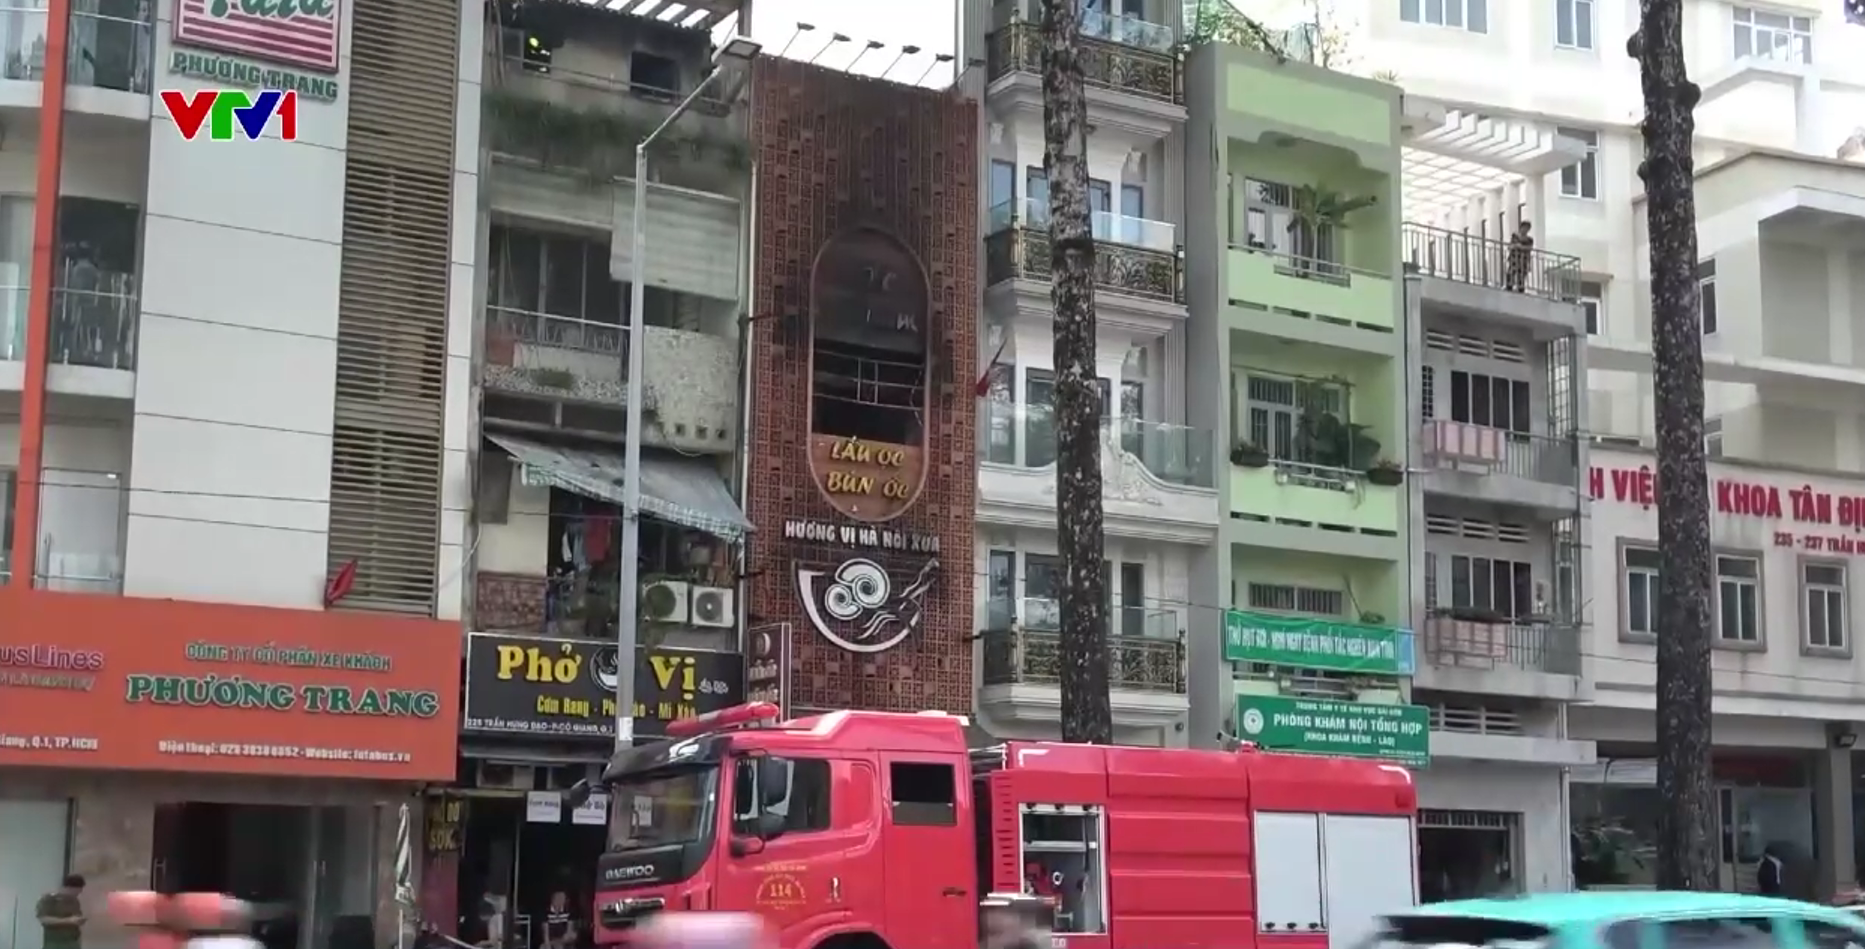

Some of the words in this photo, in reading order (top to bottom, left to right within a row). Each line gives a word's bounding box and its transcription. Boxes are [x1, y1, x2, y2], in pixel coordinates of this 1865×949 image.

[171, 52, 260, 86] PHƯƠNG
[266, 70, 338, 99] TRANG
[1717, 480, 1782, 519] KHOA
[1789, 484, 1832, 524] TÂN
[785, 520, 836, 542] HƯƠNG
[840, 526, 856, 549] VỊ
[859, 525, 878, 546] HÀ
[1774, 531, 1794, 548] 235
[1805, 535, 1823, 550] 237
[321, 652, 341, 668] XE
[498, 644, 582, 683] Phở
[650, 655, 696, 700] Vị
[126, 673, 296, 711] PHƯƠNG
[302, 684, 440, 717] TRANG
[537, 695, 559, 714] Cơm
[563, 698, 589, 717] Rang
[602, 699, 617, 717] Ph
[1273, 713, 1312, 728] PHÒNG
[1315, 714, 1345, 729] KHÁM
[1349, 717, 1367, 732] NỘI
[605, 864, 654, 880] DAEWOO
[770, 883, 792, 897] 114
